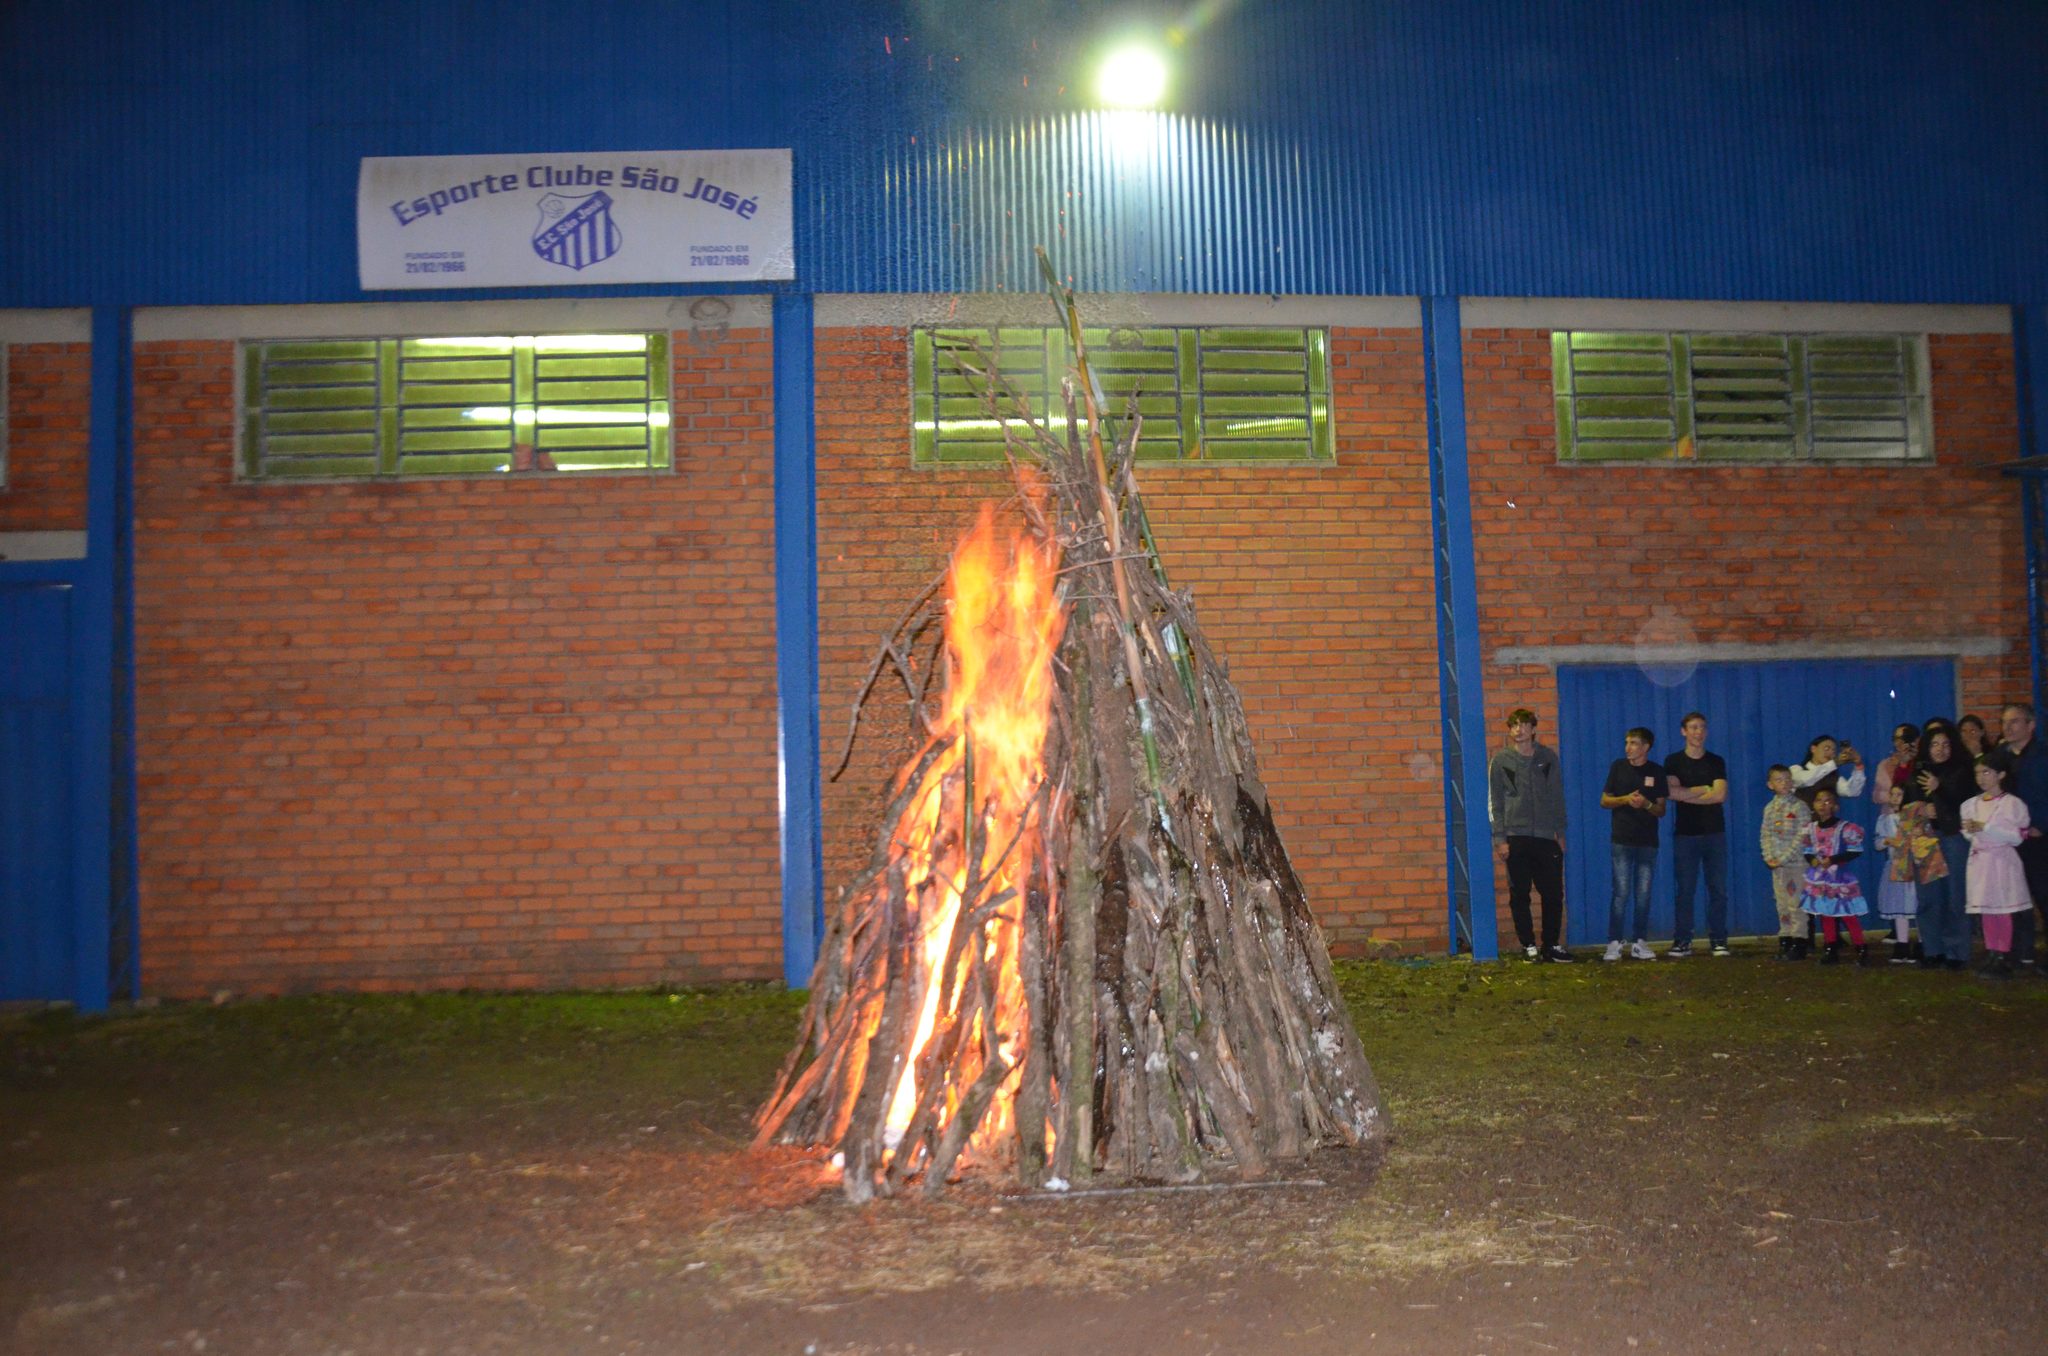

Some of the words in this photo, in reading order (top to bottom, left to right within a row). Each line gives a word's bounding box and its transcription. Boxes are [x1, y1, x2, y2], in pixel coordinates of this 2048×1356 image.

[391, 174, 518, 226] Esporte
[527, 165, 613, 188] Clube
[621, 166, 679, 193] São
[683, 177, 759, 220] José
[690, 245, 733, 253] FUNDADO
[690, 255, 750, 267] 21/02/1966
